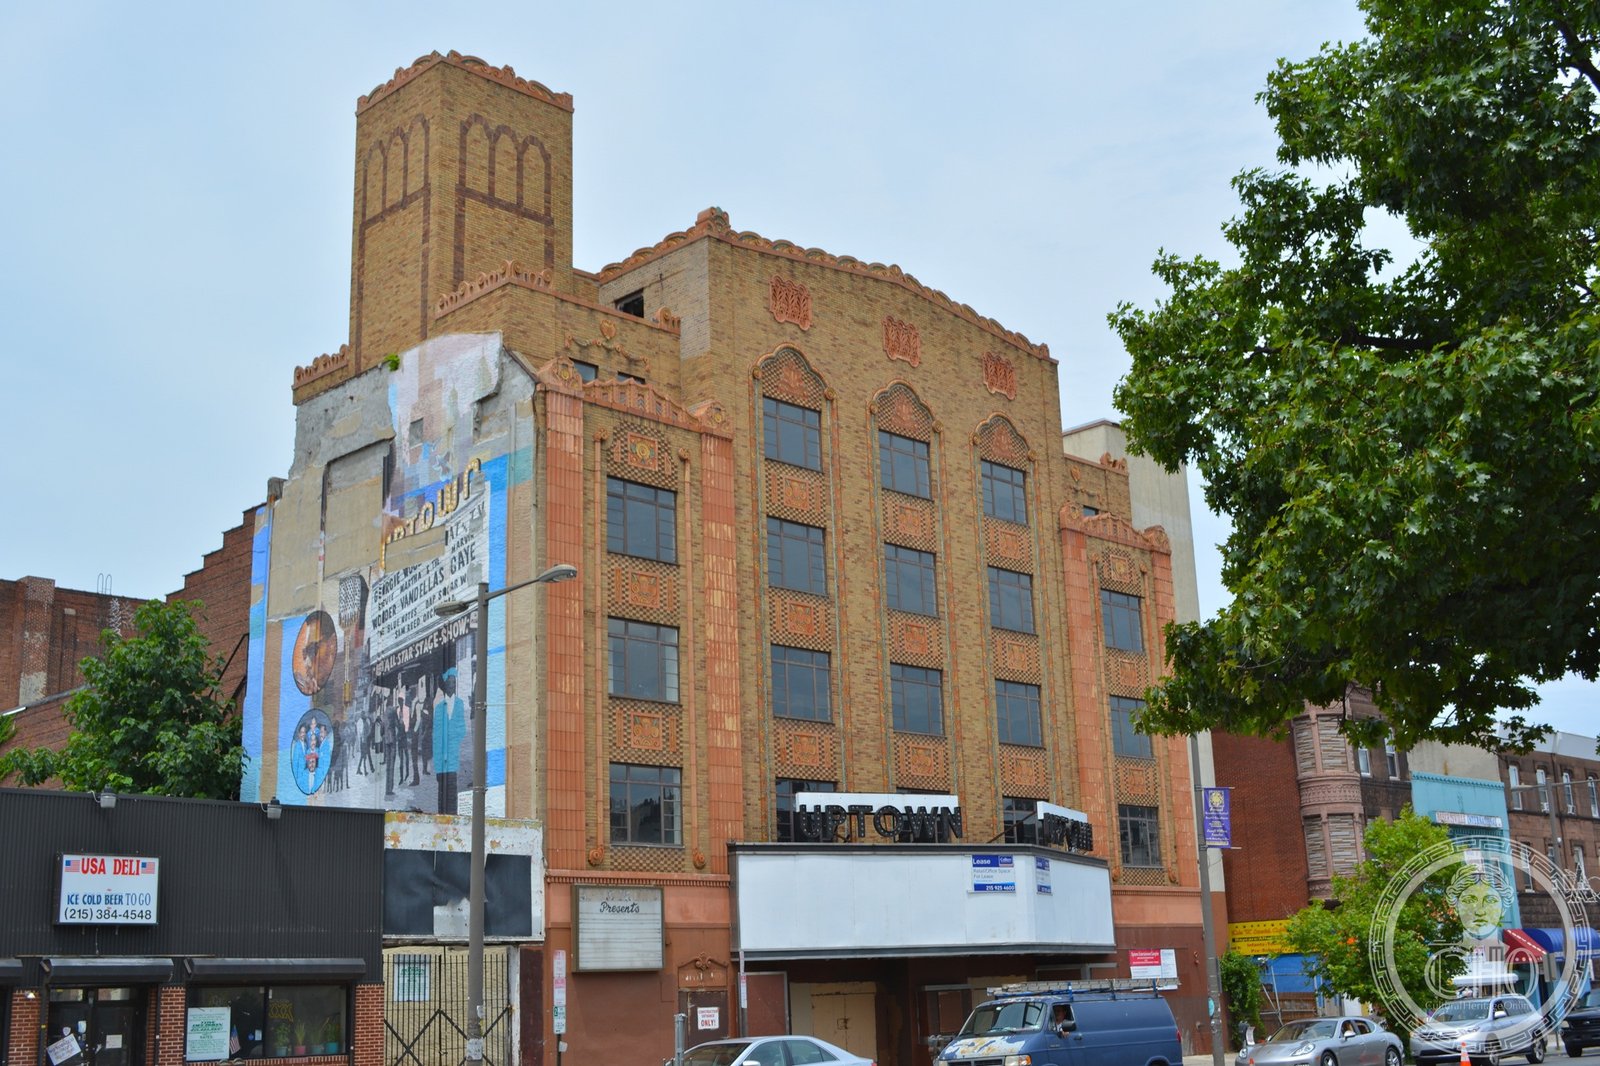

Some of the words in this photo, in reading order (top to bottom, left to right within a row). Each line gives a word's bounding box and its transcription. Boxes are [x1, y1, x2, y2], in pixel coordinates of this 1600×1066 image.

[450, 541, 476, 575] GAYE
[399, 572, 421, 594] MARTHA
[372, 604, 396, 630] WONDER
[400, 566, 445, 610] VANDELLAS
[401, 606, 418, 623] NOTES
[407, 617, 421, 632] REED
[799, 804, 963, 839] UPTOWN
[81, 857, 106, 875] USA
[113, 858, 140, 876] DELI
[67, 893, 79, 905] ICE
[82, 893, 102, 905] COLD
[104, 893, 124, 905] BEER
[125, 893, 137, 906] TO
[138, 892, 151, 906] GO
[600, 901, 640, 914] Presents
[64, 907, 93, 921] (215)
[96, 909, 152, 920] 384-4548
